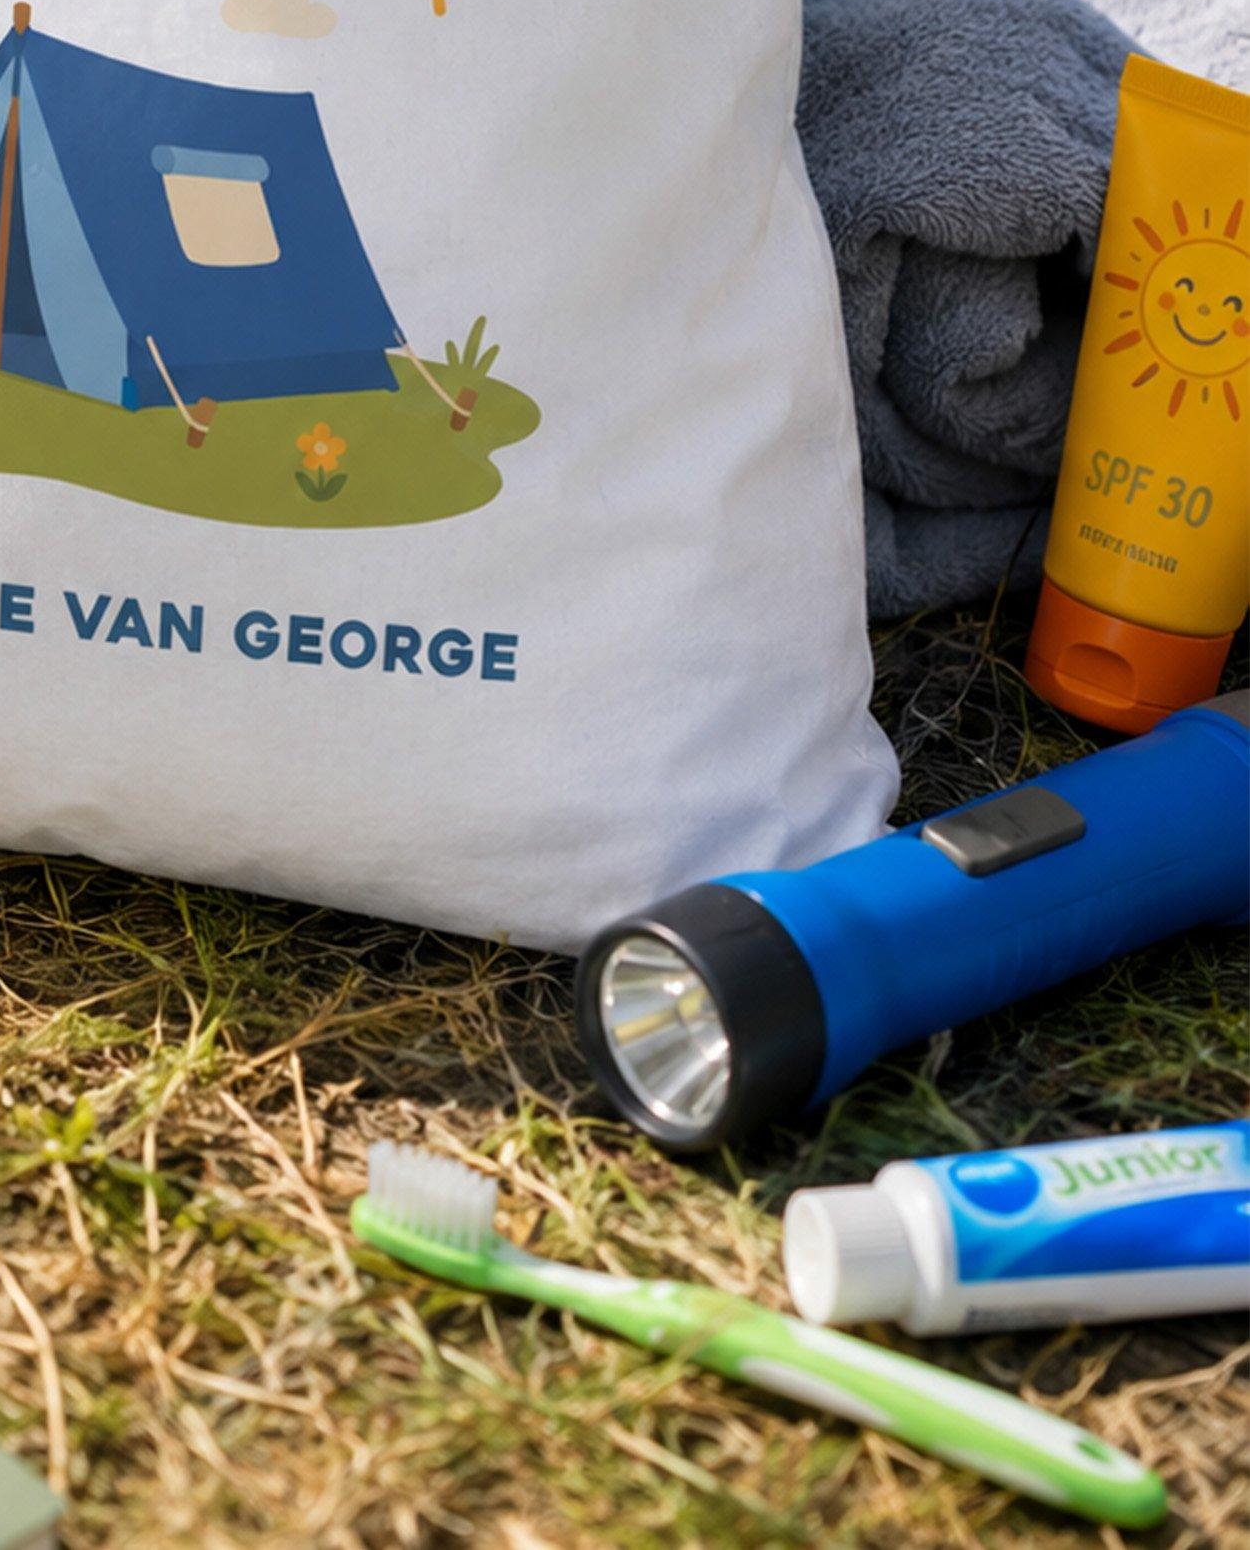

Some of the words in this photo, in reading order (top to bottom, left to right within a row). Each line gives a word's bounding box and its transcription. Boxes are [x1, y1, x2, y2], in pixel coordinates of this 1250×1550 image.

[1085, 450, 1154, 505] SPF
[1158, 476, 1213, 528] 30
[63, 591, 204, 653] VAN
[234, 610, 518, 682] GEORGE
[1051, 1141, 1224, 1197] Junior
